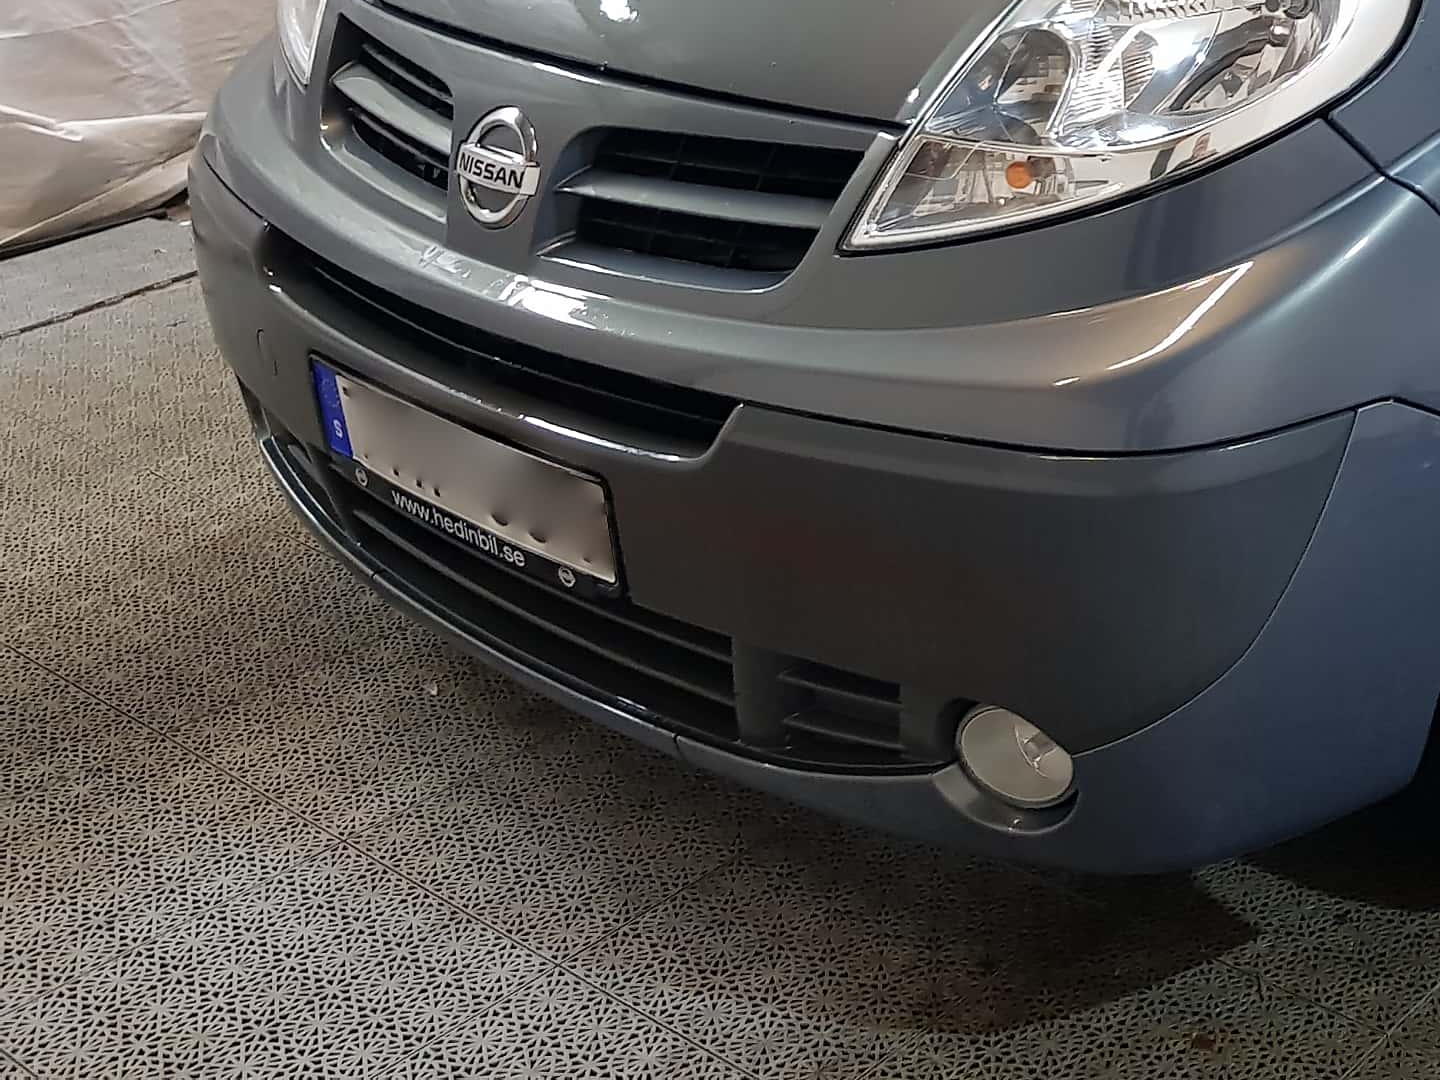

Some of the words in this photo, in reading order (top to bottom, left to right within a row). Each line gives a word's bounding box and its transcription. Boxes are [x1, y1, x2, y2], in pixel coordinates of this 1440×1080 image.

[459, 151, 525, 189] NISSAN
[333, 418, 344, 439] S
[391, 488, 526, 568] www.hedinbil.se
